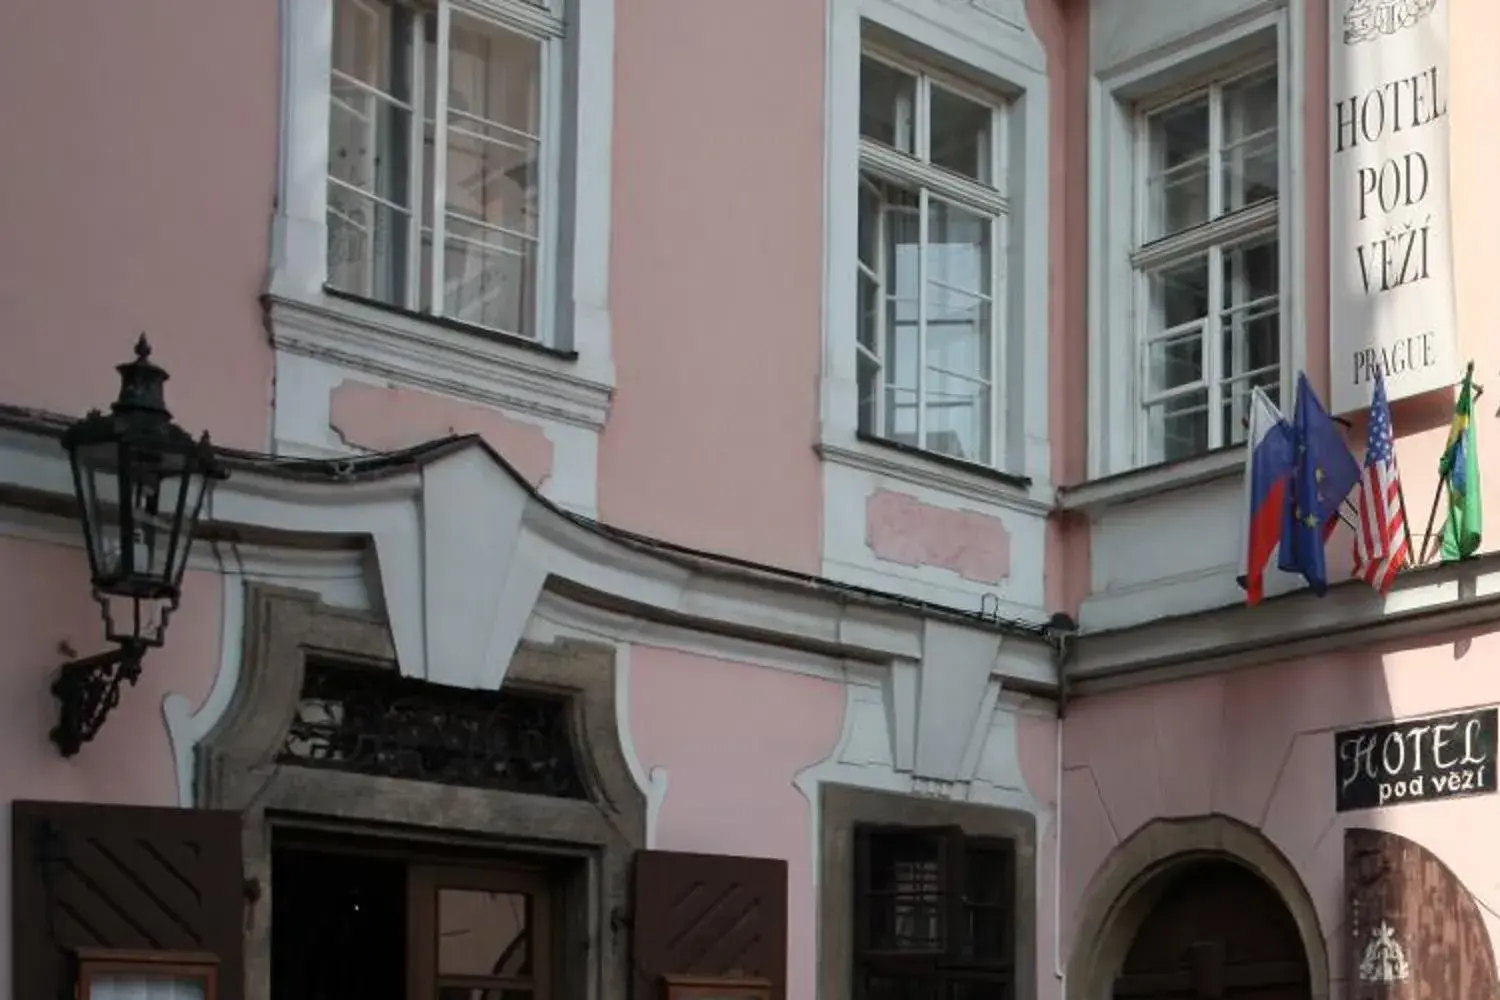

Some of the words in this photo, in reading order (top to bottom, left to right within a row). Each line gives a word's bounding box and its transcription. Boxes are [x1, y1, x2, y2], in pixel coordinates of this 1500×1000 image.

[1335, 67, 1447, 153] HOTEL
[1357, 151, 1430, 220] POD
[1355, 215, 1432, 296] VĚŽÍ
[1353, 331, 1436, 385] PRAGUE
[1340, 719, 1486, 790] HOTEL
[1379, 775, 1424, 806] pod
